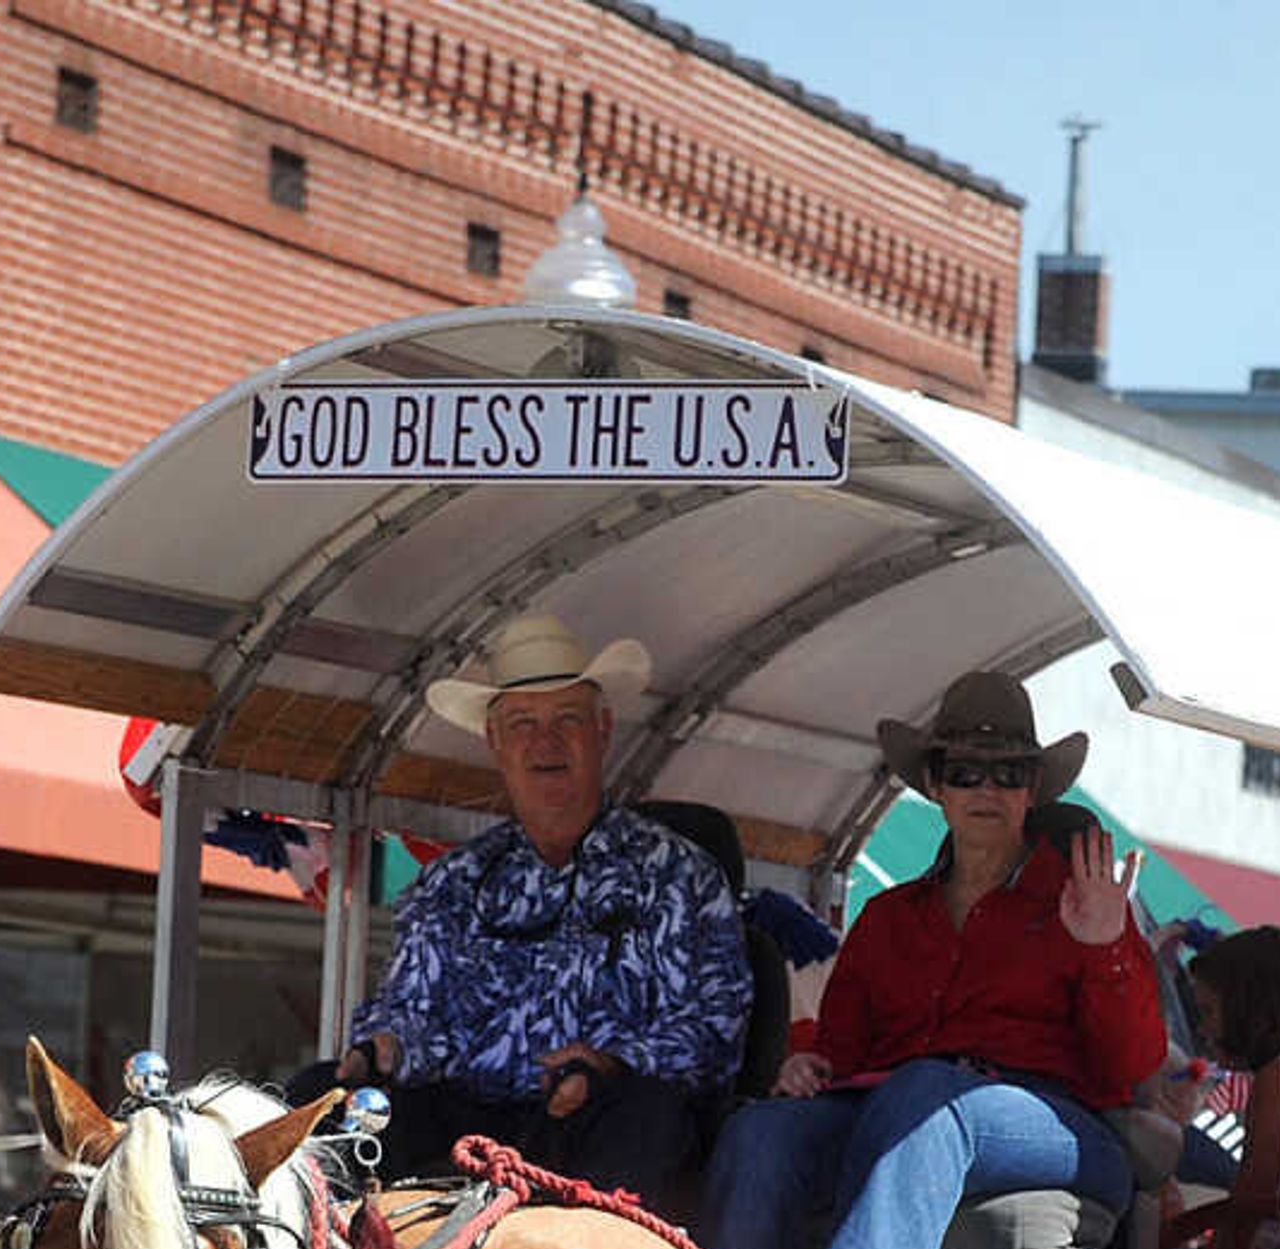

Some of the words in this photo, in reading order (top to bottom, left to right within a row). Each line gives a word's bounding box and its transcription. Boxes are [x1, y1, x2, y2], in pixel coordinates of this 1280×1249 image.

[278, 395, 369, 468] GOD
[391, 395, 544, 468] BLESS
[565, 395, 652, 468] THE
[674, 395, 815, 468] U.S.A.
